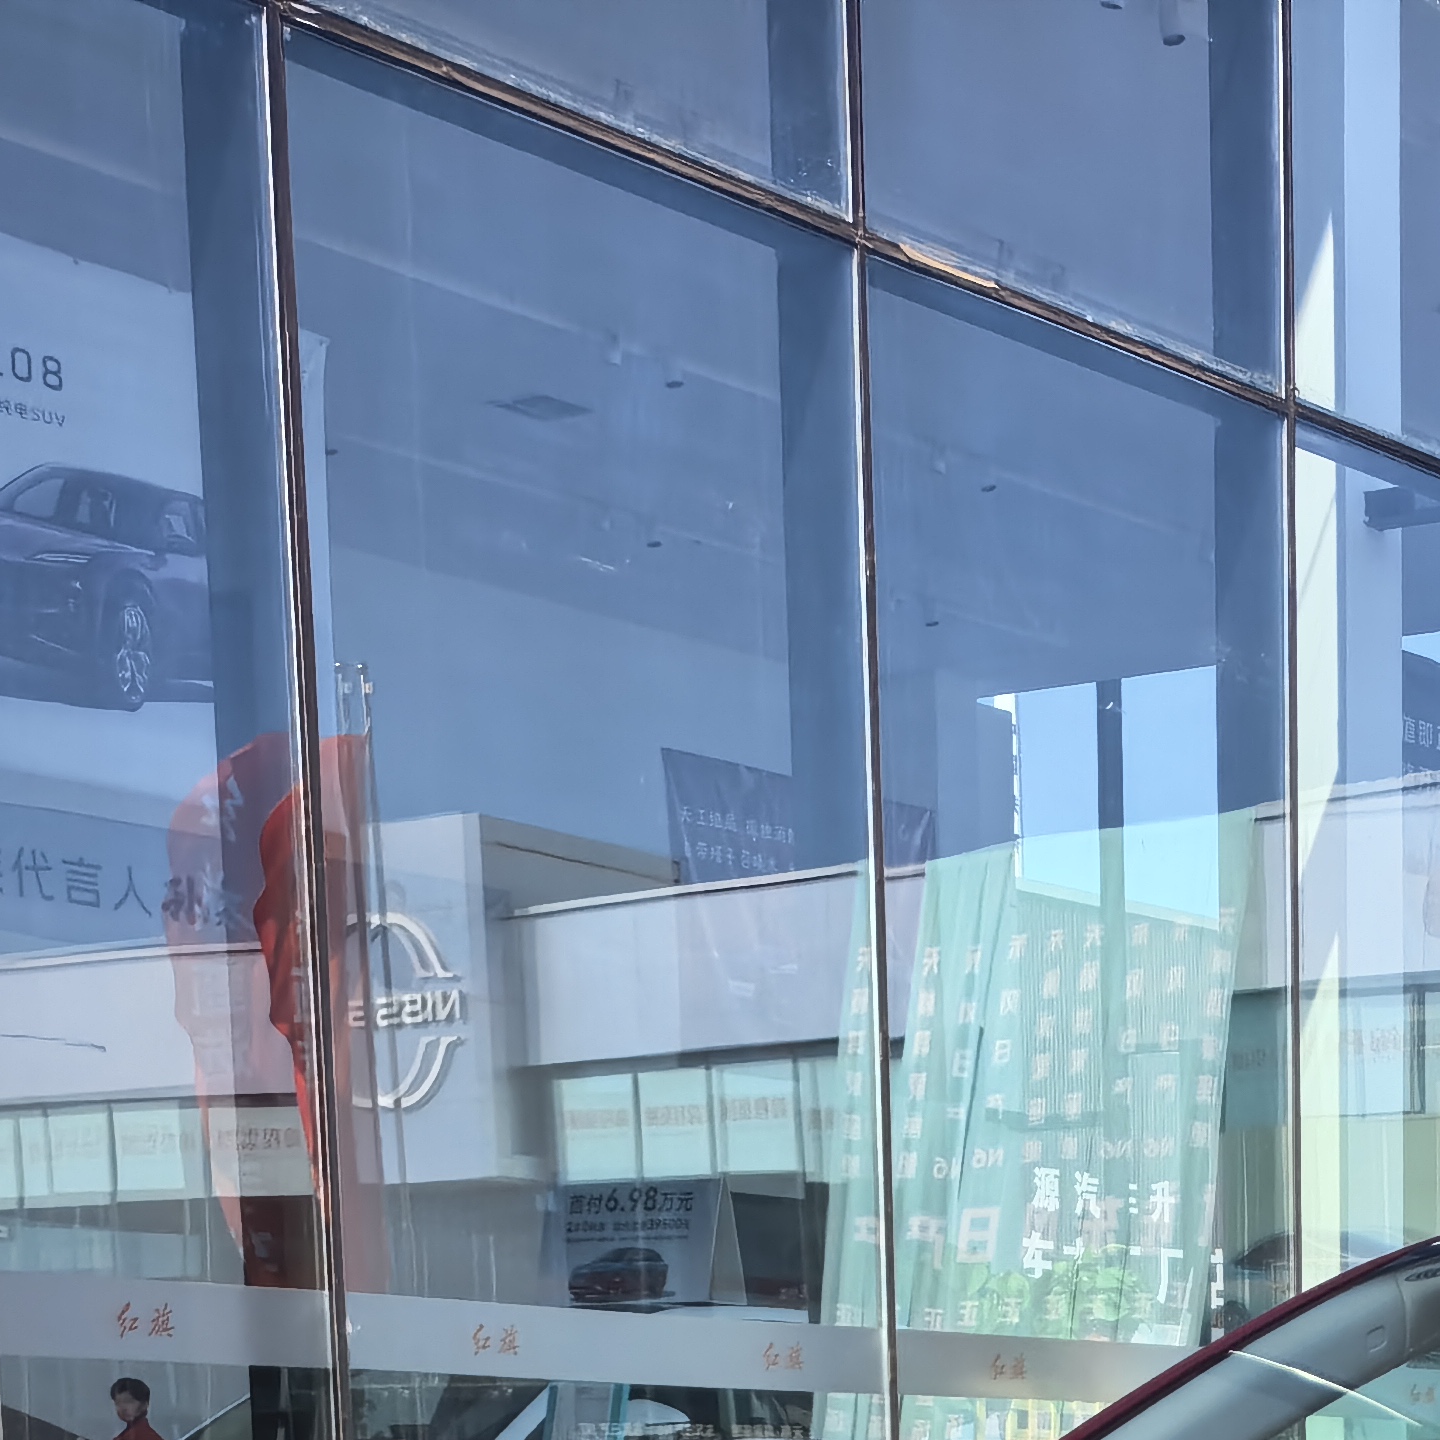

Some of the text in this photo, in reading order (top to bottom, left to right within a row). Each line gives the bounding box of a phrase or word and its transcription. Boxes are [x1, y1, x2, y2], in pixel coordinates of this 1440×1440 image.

[567, 1185, 694, 1216] 首付6.98万元
[116, 1301, 177, 1339] 红旗
[470, 1322, 521, 1357] 红旗
[761, 1340, 805, 1373] 红旗
